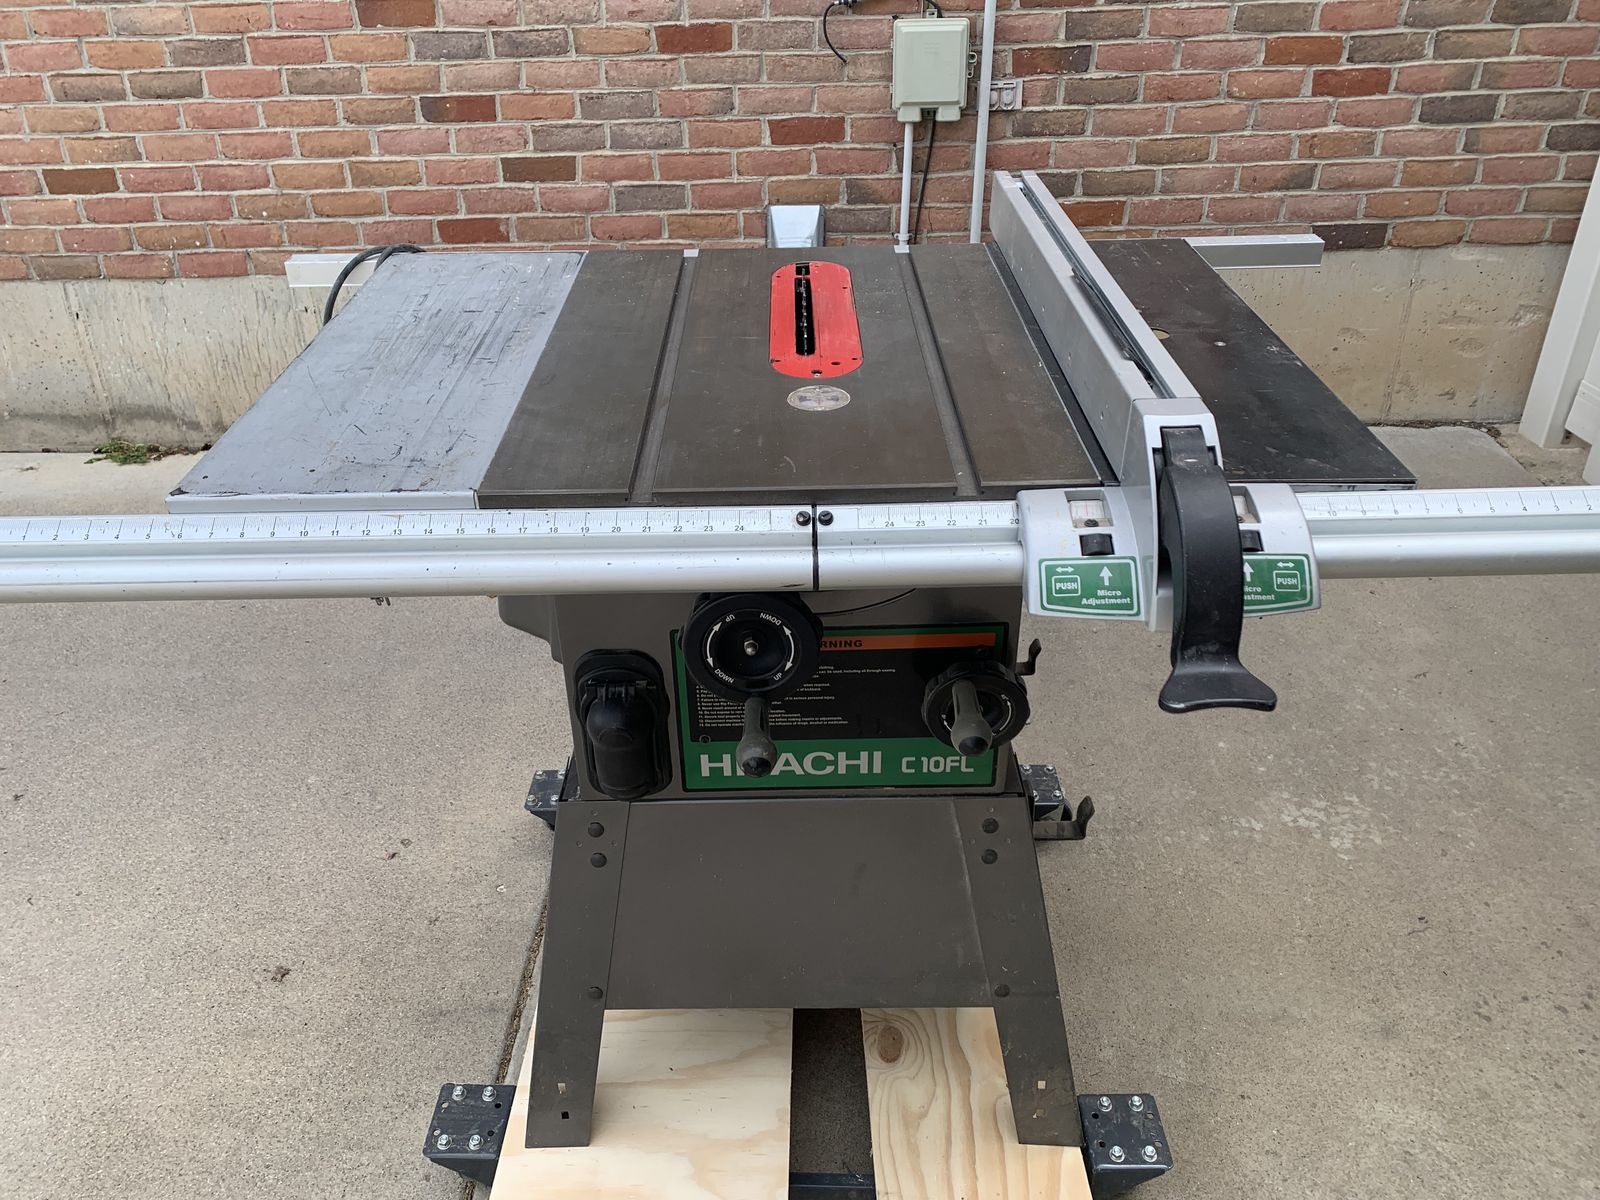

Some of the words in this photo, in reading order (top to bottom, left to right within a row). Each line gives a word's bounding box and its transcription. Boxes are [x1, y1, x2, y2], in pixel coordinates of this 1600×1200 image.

[725, 614, 736, 622] UP
[760, 612, 782, 626] DOWN
[820, 640, 863, 648] RNING
[714, 668, 735, 684] DOWN
[773, 672, 783, 681] UP
[700, 751, 882, 777] HACHI
[901, 757, 915, 773] C
[921, 756, 974, 773] 10FL
